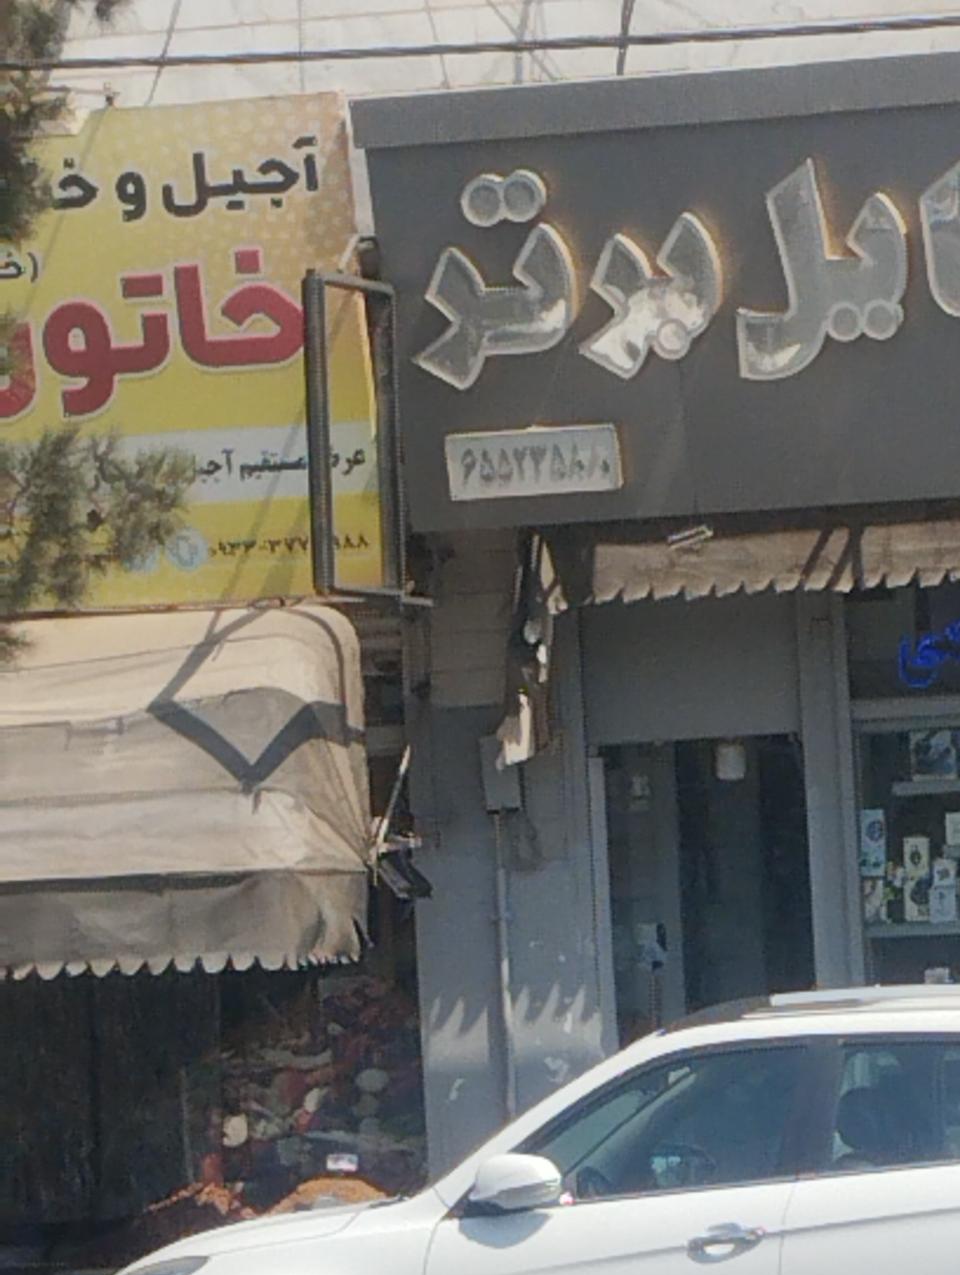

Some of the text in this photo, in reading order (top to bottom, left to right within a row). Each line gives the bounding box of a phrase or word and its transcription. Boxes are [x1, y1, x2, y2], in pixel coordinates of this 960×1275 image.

[116, 171, 146, 222] و
[162, 136, 318, 217] آجیل
[239, 450, 307, 482] ستقیم
